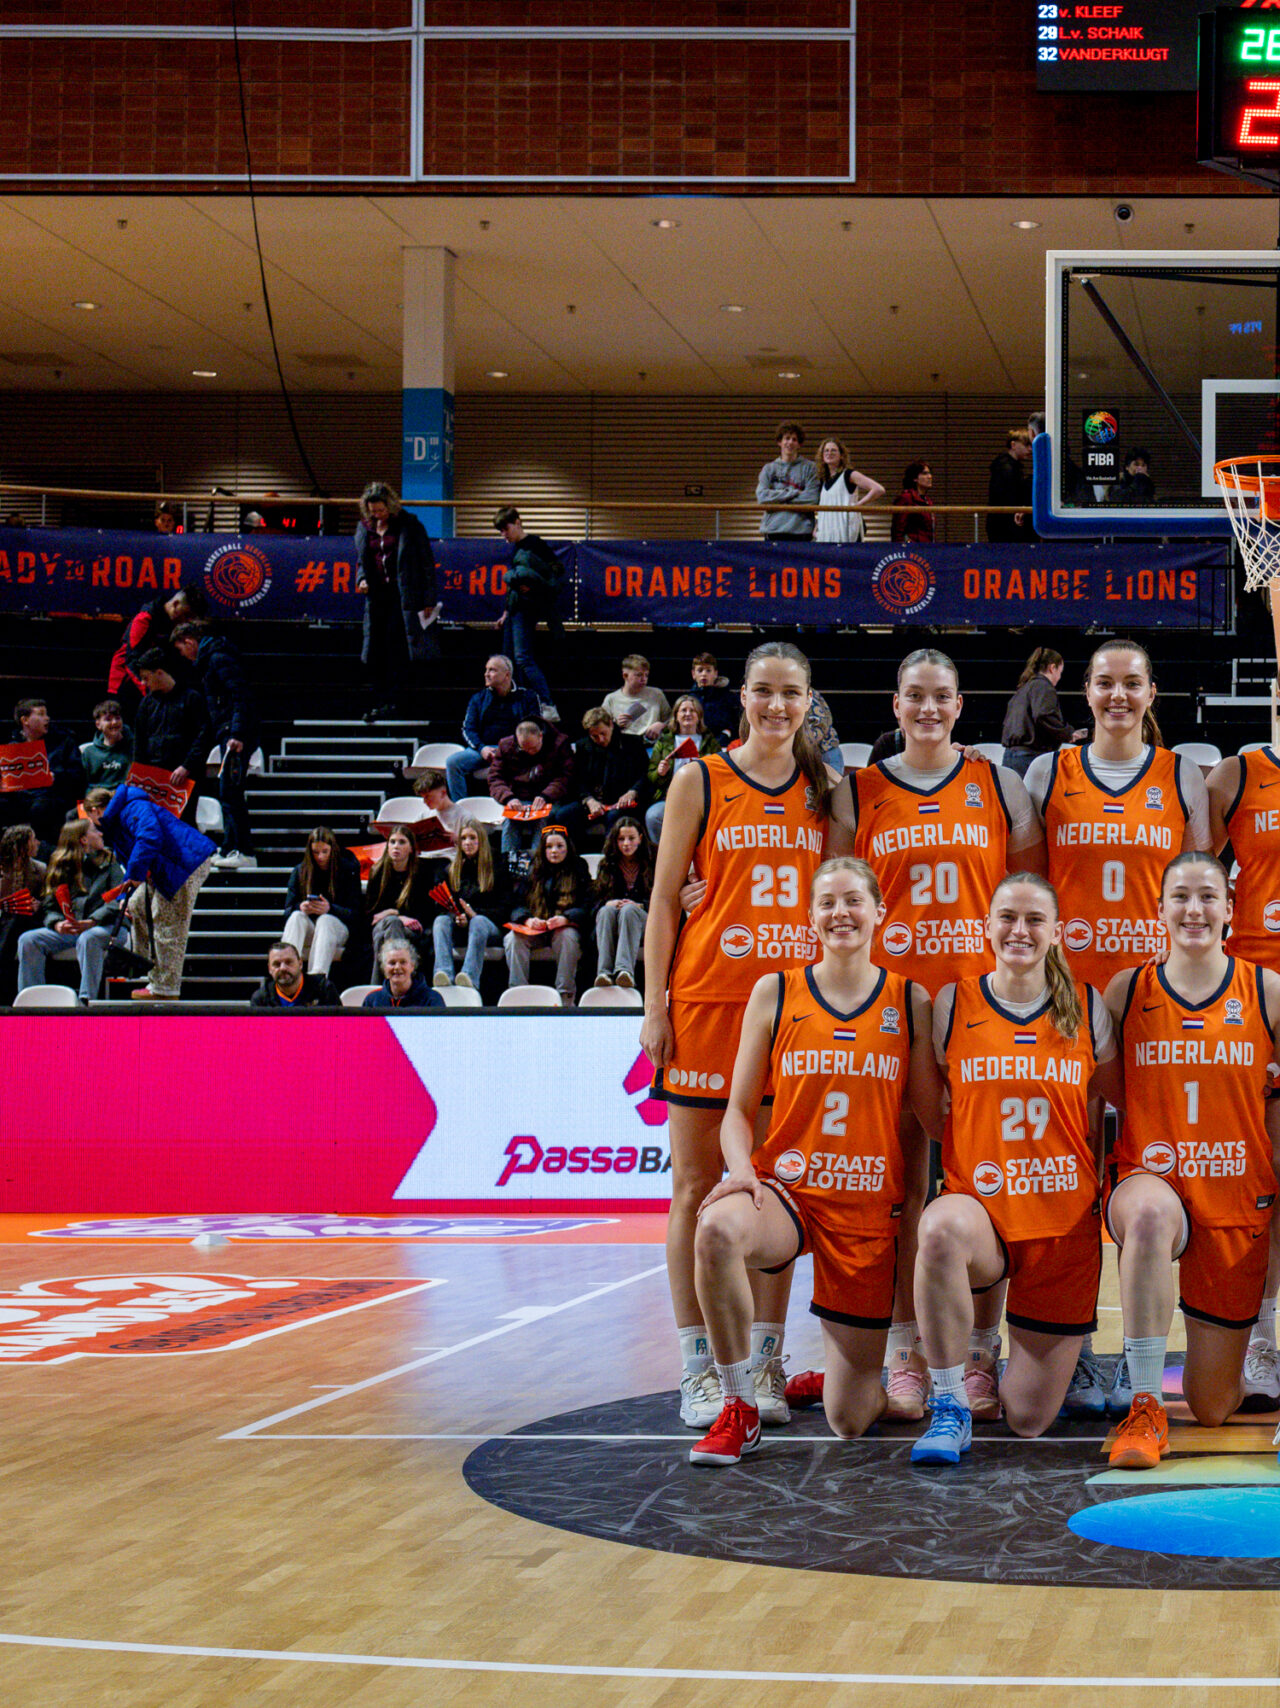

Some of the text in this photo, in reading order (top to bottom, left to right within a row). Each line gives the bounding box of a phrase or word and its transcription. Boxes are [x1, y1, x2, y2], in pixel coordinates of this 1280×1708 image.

[1038, 4, 1124, 18] 23 v. KLEEF
[1087, 27, 1144, 39] SCHAIK
[1038, 47, 1169, 60] 32 VANDERKLUGT
[414, 436, 426, 461] D
[1088, 453, 1114, 466] FIBA
[92, 555, 182, 590] ROAR
[605, 565, 842, 599] ORANGE LIONS
[963, 568, 1198, 601] ORANGE LIONS
[716, 824, 823, 855] NEDERLAND
[872, 823, 988, 857] NEDERLAND
[1056, 822, 1172, 850] NEDERLAND
[751, 864, 798, 908] 23
[910, 861, 959, 905] 20
[1102, 860, 1126, 902] 0
[757, 924, 817, 943] STAATS
[915, 919, 984, 938] STAATS
[1096, 918, 1168, 936] STAATS
[757, 940, 817, 961] LOTERIJ
[915, 936, 984, 955] LOTERIJ
[1096, 934, 1167, 954] LOTERIJ
[1135, 1040, 1254, 1067] NEDERLAND
[781, 1049, 900, 1082] NEDERLAND
[960, 1056, 1082, 1085] NEDERLAND
[821, 1091, 850, 1137] 2
[1183, 1080, 1199, 1125] 1
[1000, 1096, 1050, 1141] 29
[1176, 1141, 1246, 1160] STAATS
[809, 1151, 886, 1174] STAATS
[1006, 1154, 1077, 1177] STAATS
[1176, 1158, 1247, 1178] LOTERIJ
[806, 1169, 885, 1192] LOTERIJ
[1006, 1173, 1078, 1196] LOTERIJ
[71, 1226, 546, 1237] GAME
